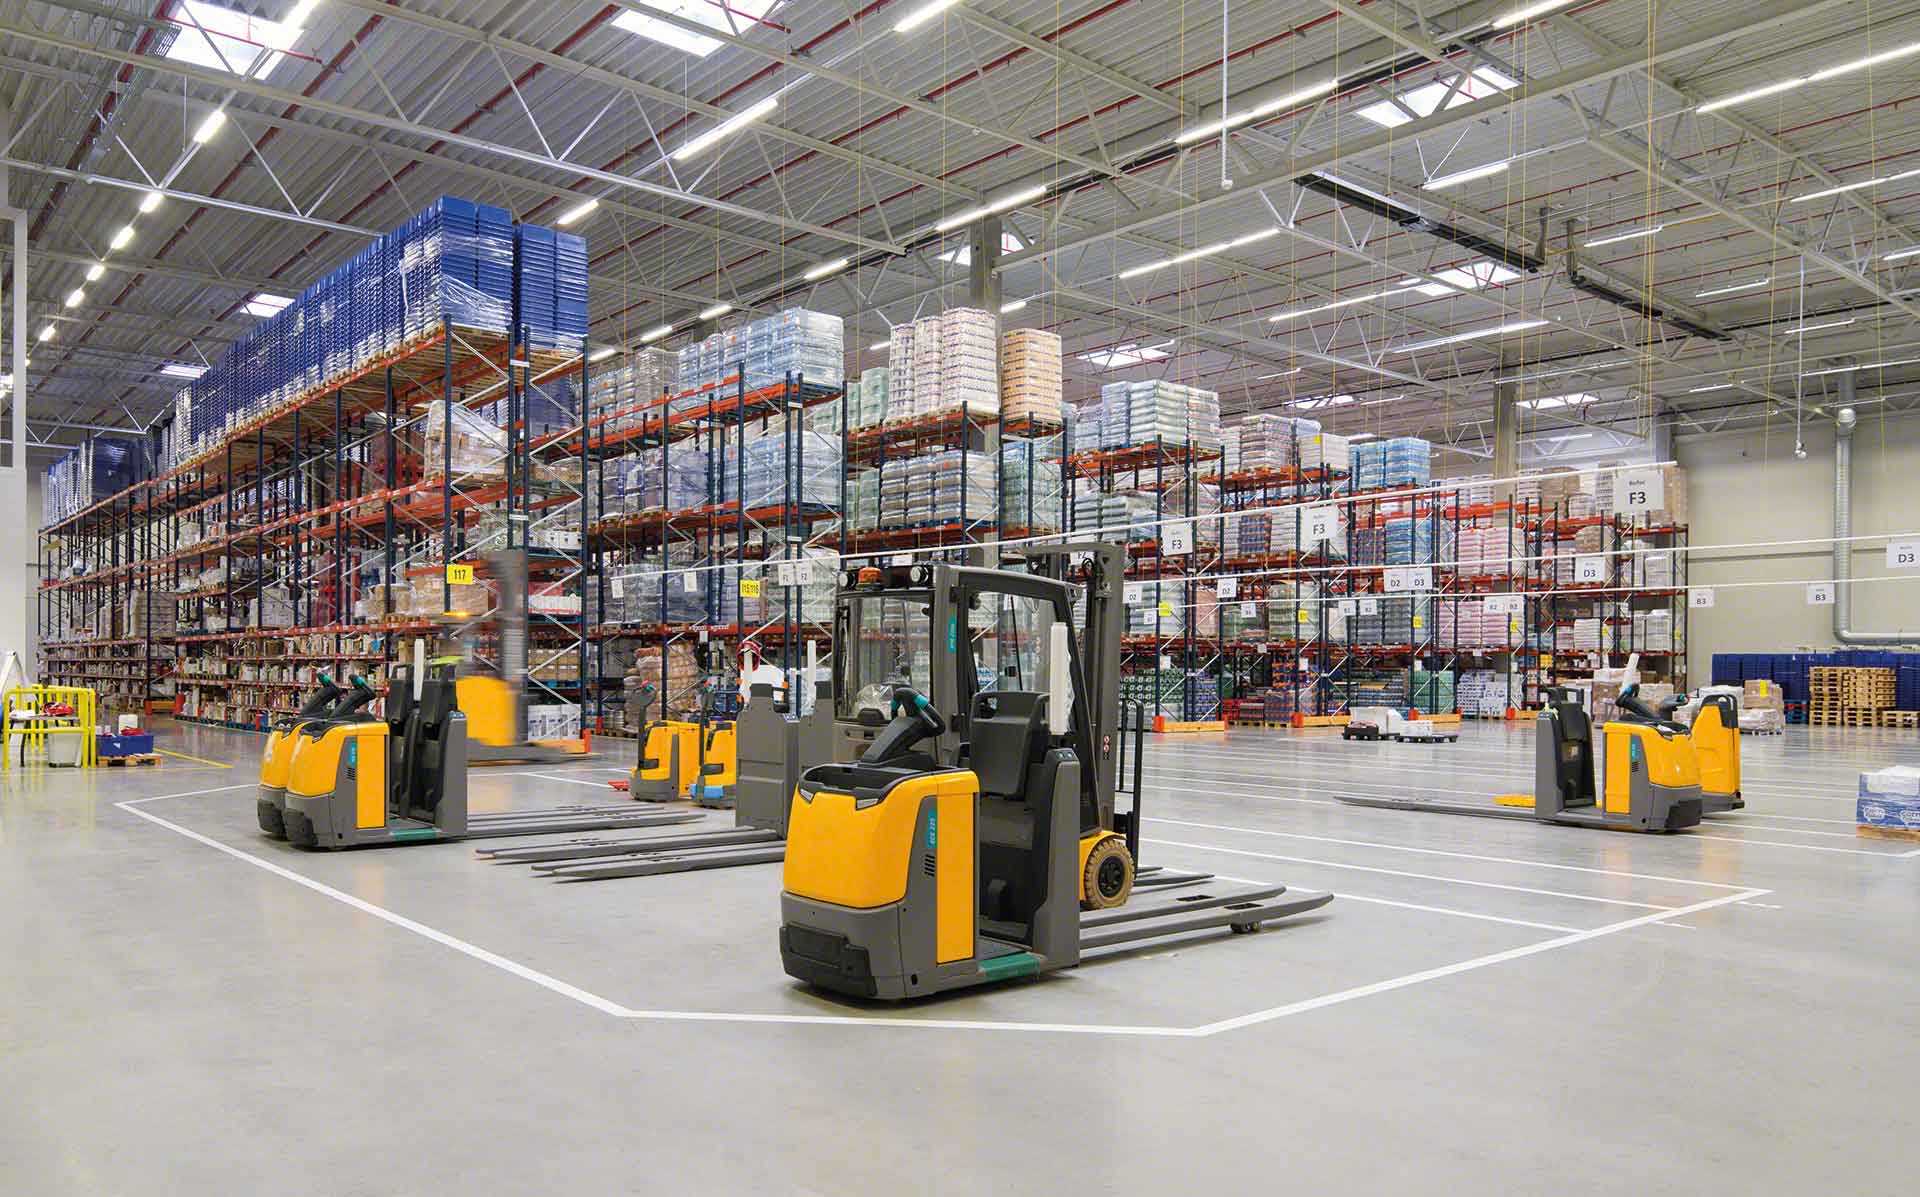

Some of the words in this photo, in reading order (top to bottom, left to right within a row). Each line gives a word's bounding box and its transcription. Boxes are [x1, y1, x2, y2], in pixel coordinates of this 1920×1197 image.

[1629, 491, 1646, 504] F3
[1313, 523, 1326, 535] F3
[1172, 540, 1182, 549] F3
[1898, 553, 1914, 563] D3
[454, 569, 466, 580] 117
[1583, 569, 1596, 578] D3
